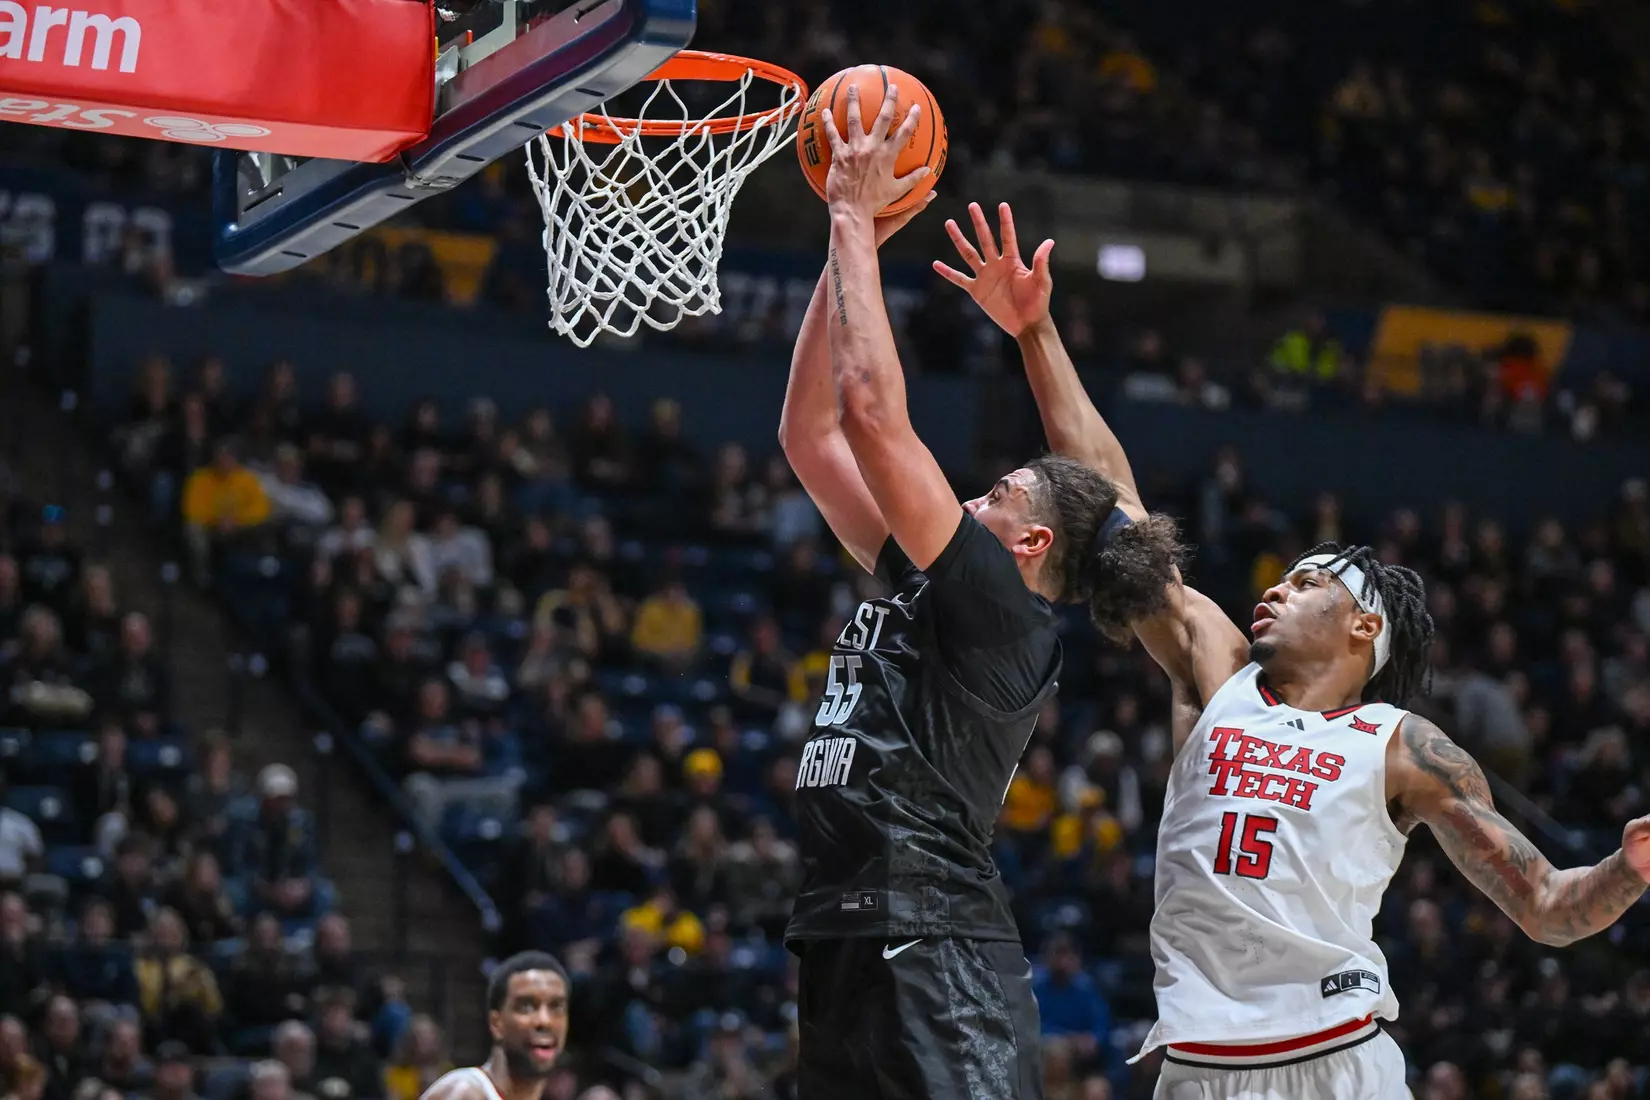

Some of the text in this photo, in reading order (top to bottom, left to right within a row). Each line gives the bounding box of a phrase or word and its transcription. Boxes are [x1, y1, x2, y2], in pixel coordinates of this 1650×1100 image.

[0, 0, 142, 73] arm
[0, 97, 138, 129] Sta
[815, 655, 863, 727] 55
[1208, 726, 1346, 782] TEXAS
[1208, 759, 1319, 811] TECH
[1213, 811, 1278, 880] 15
[864, 896, 874, 905] XL
